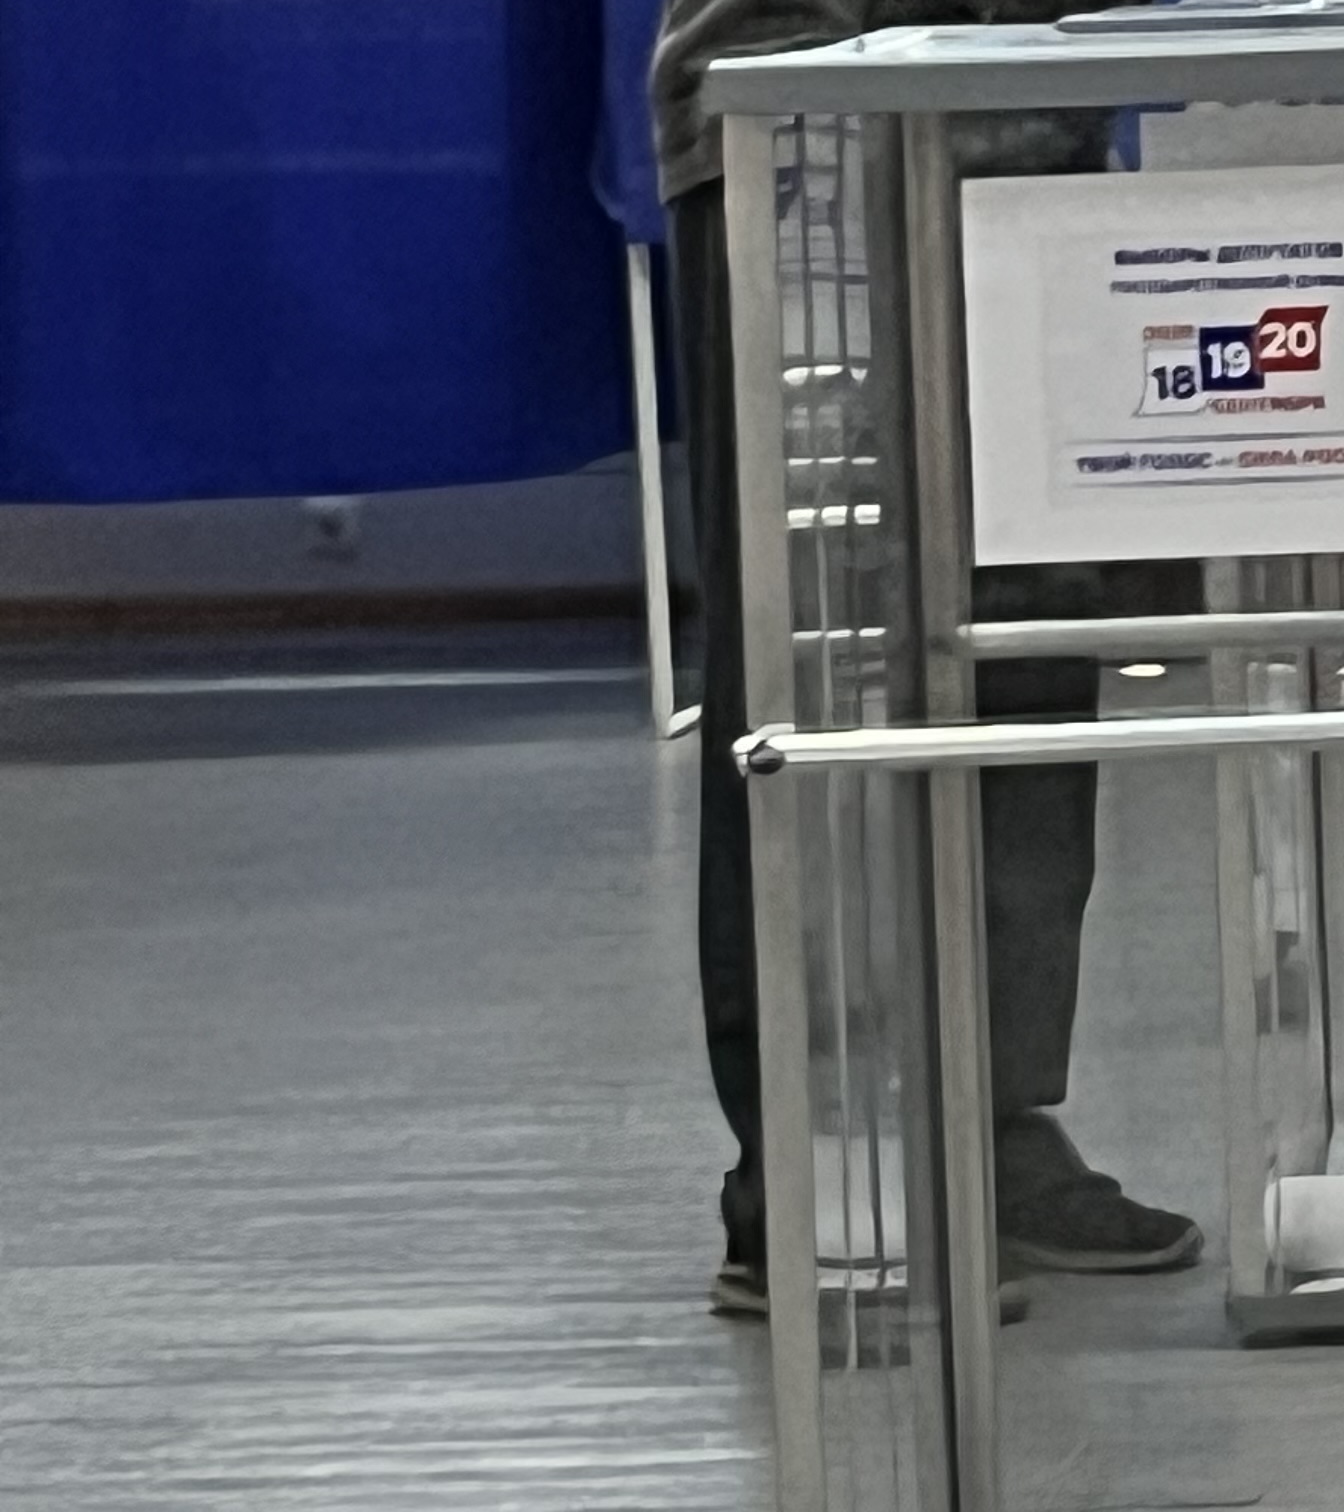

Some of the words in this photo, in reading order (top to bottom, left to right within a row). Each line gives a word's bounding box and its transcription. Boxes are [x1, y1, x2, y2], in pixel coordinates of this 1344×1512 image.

[1151, 365, 1197, 400] 18
[1207, 341, 1252, 379] 19
[1258, 321, 1318, 359] 20
